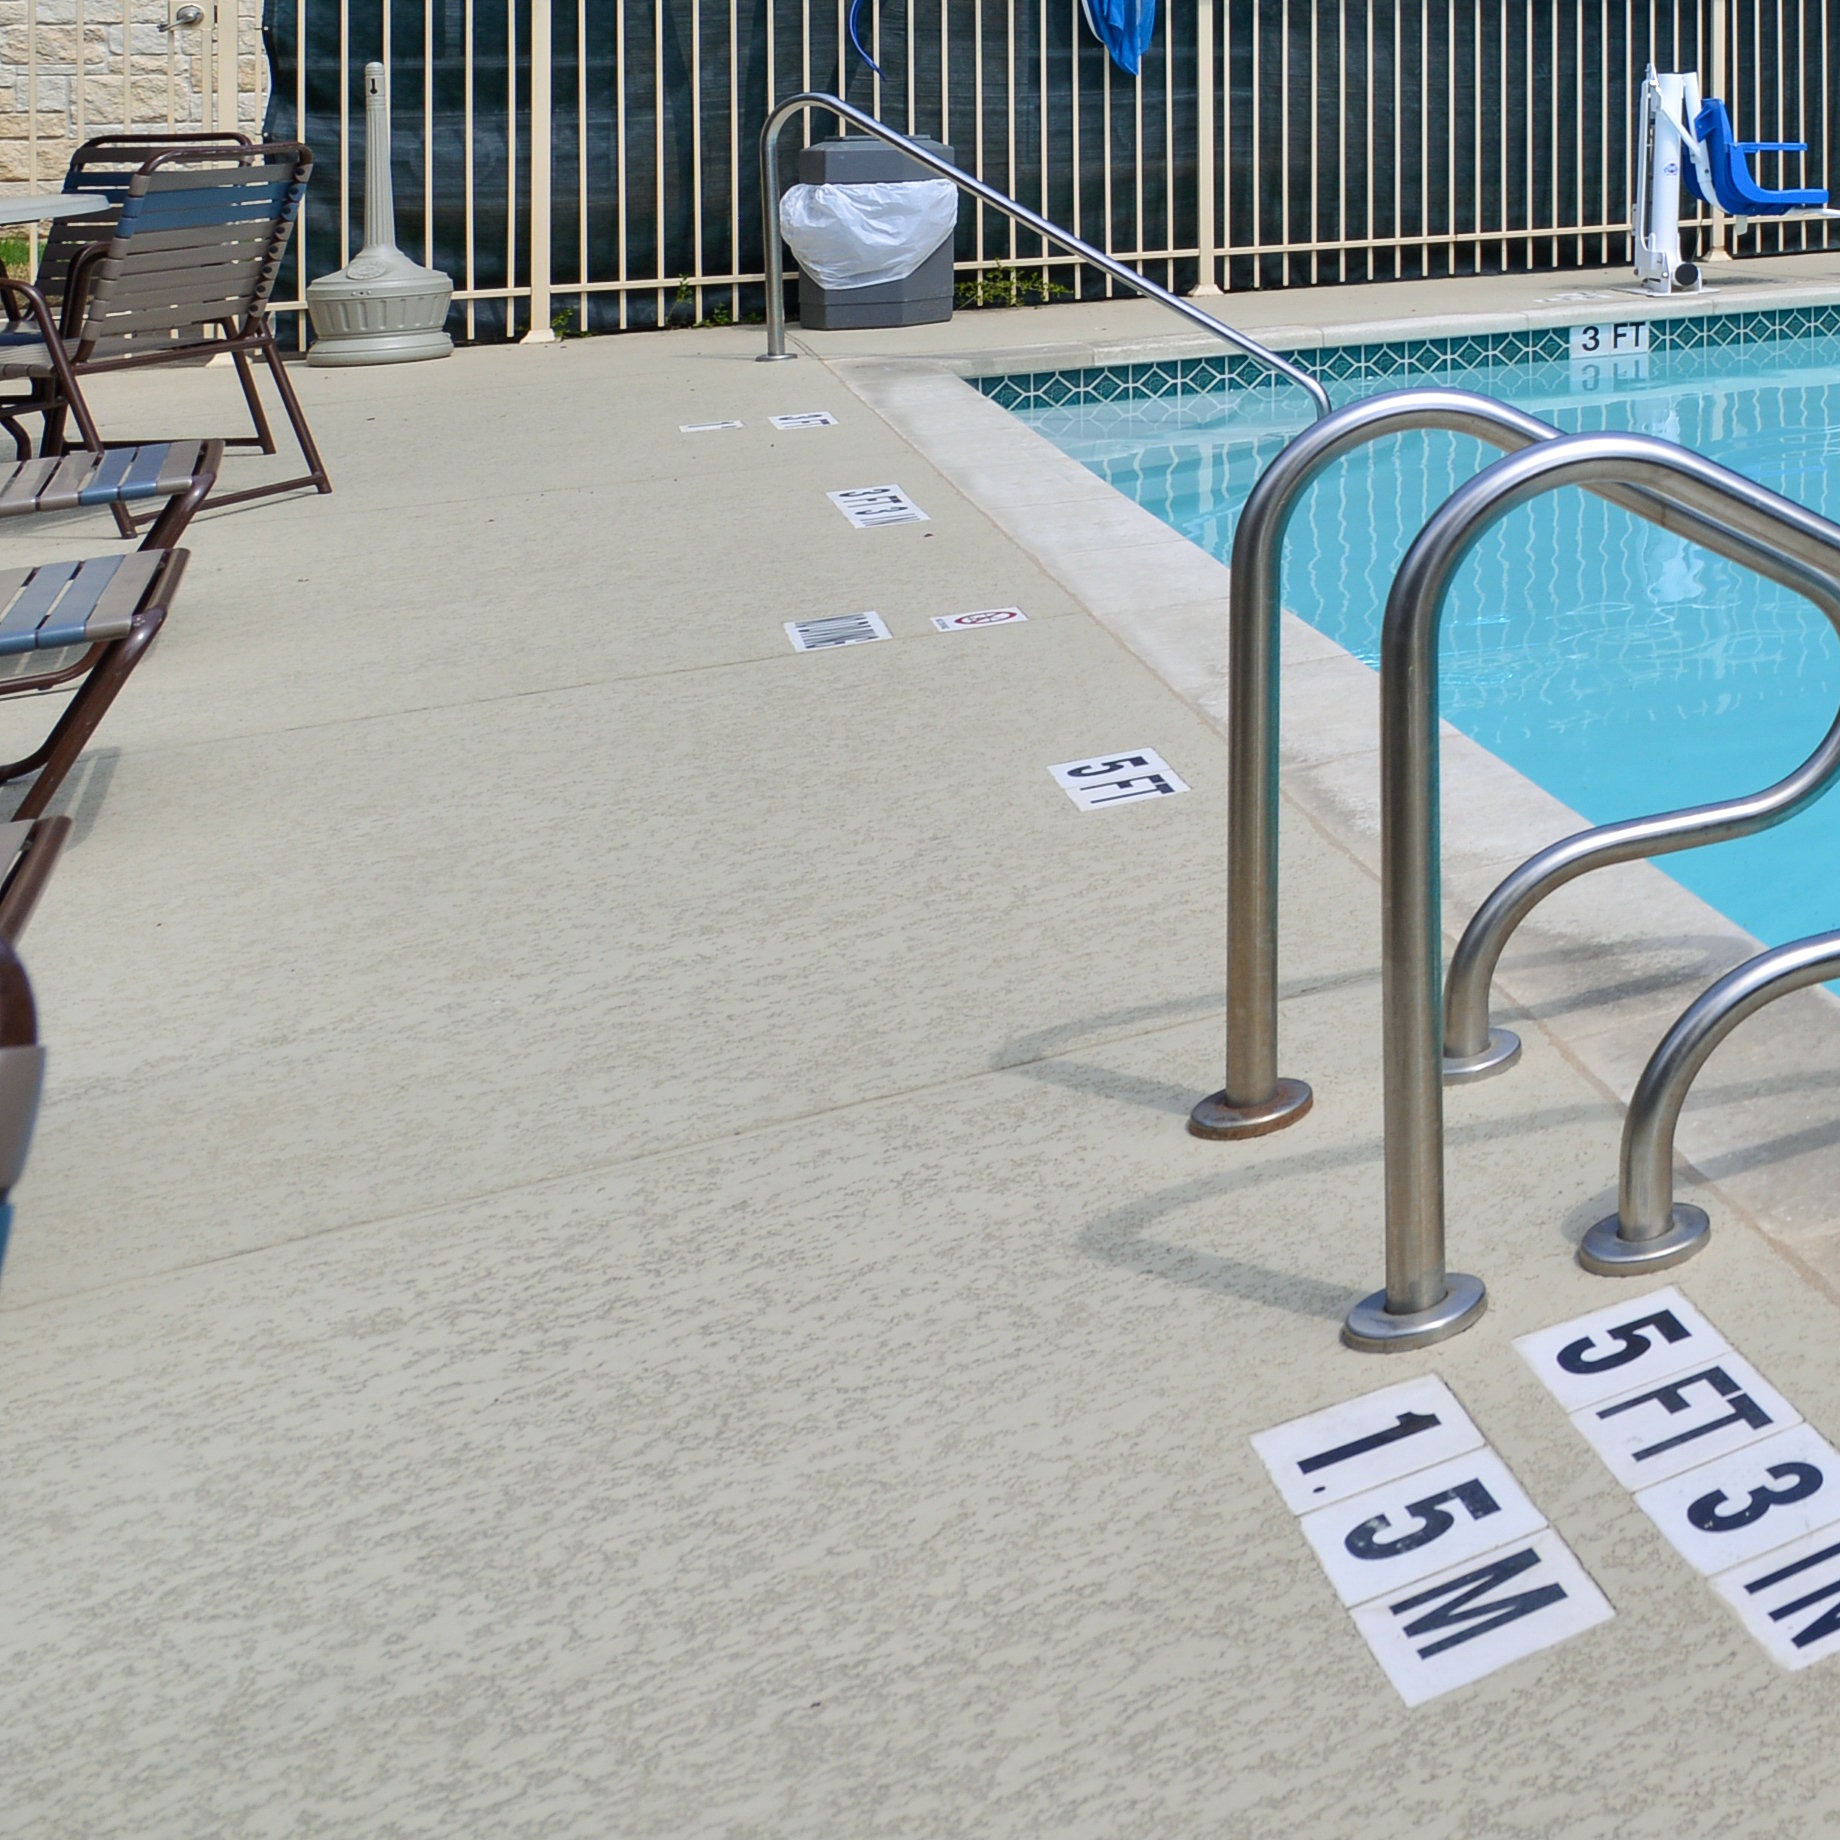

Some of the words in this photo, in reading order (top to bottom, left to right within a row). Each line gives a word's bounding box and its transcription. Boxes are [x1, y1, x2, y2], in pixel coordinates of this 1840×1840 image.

[1582, 326, 1600, 351] 3
[1613, 321, 1646, 349] FT
[839, 489, 890, 497] 3
[843, 495, 902, 508] FT
[855, 507, 908, 515] 3
[860, 513, 920, 526] IN
[1067, 756, 1149, 777] 5
[1080, 774, 1175, 804] FT
[1556, 1309, 1691, 1374] 5
[1595, 1365, 1773, 1462] FT
[1687, 1461, 1824, 1532] 3
